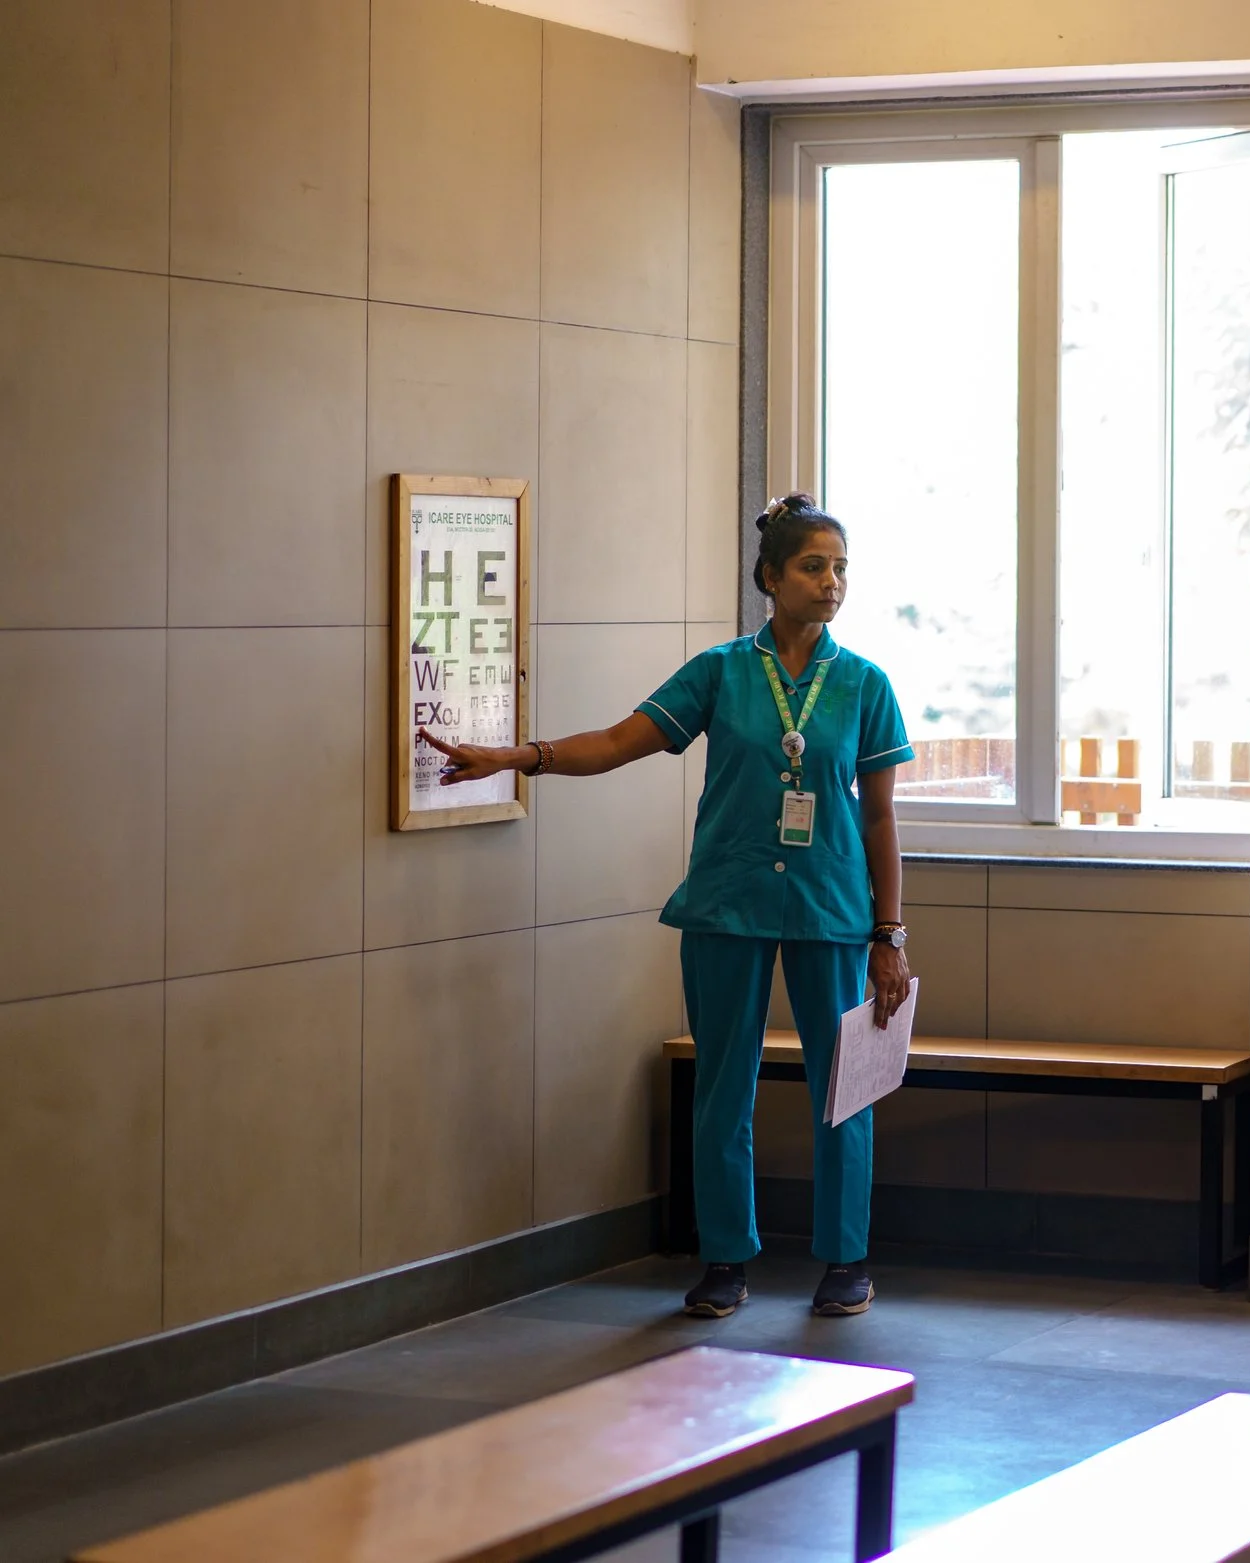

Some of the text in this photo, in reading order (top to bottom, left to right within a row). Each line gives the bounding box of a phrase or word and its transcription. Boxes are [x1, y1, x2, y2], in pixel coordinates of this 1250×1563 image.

[428, 512, 454, 525] ICARE
[456, 513, 473, 525] EYE
[474, 514, 514, 526] HOSPITAL
[421, 551, 506, 606] H E
